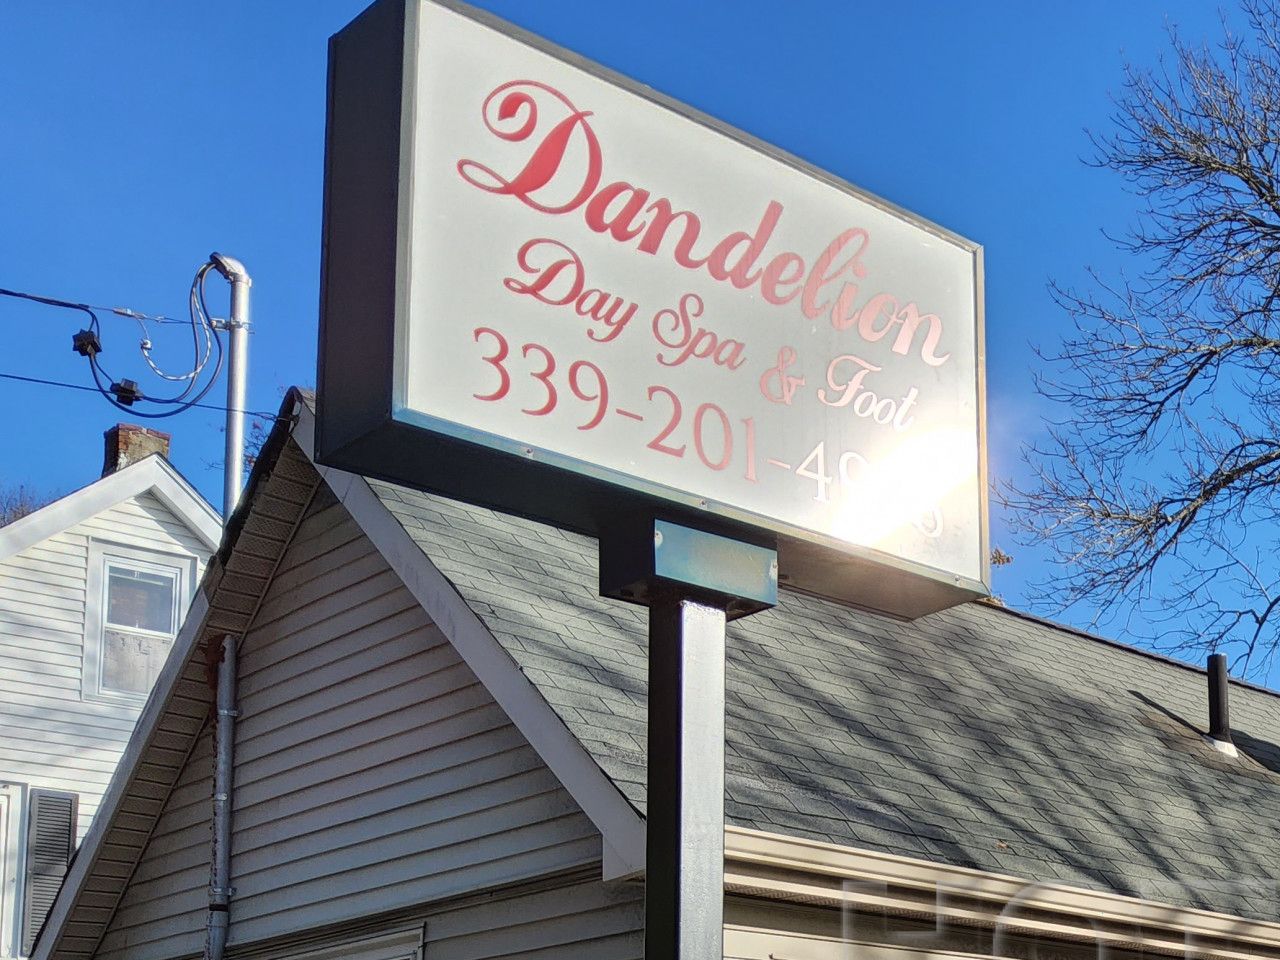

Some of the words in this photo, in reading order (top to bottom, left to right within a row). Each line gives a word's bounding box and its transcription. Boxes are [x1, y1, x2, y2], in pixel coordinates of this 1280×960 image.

[456, 79, 951, 366] Dandelion
[503, 238, 639, 342] Day
[652, 293, 747, 370] Spa
[759, 346, 805, 405] &
[818, 355, 918, 433] Foot
